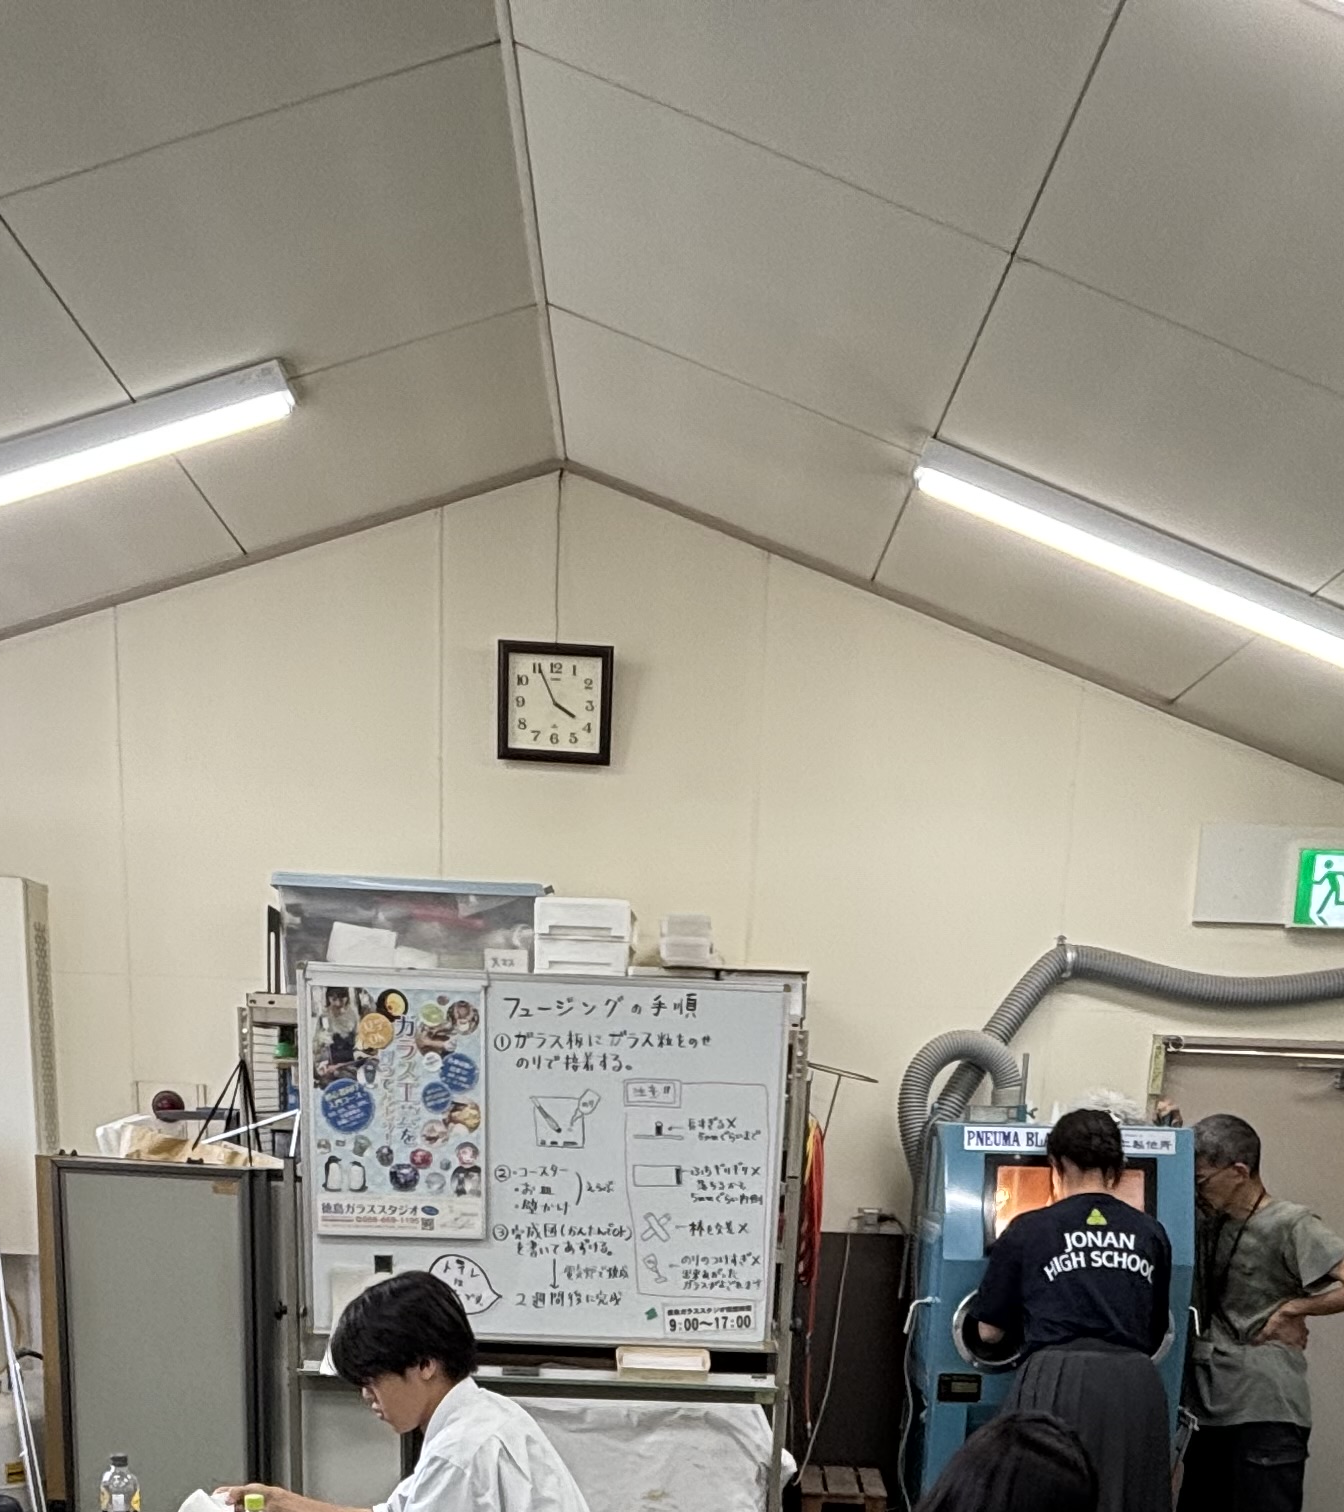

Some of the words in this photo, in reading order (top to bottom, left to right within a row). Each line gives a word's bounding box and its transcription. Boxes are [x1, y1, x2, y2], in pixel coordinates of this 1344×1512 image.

[549, 662, 563, 674] 12
[516, 674, 529, 686] 10
[583, 678, 593, 690] 2
[516, 696, 526, 707] 9
[585, 700, 595, 712] 3
[517, 718, 527, 730] 8
[582, 722, 592, 733] 4
[531, 730, 541, 741] 7
[549, 733, 559, 744] 6
[568, 732, 578, 744] 5
[503, 993, 697, 1019] フュージングの手順
[967, 1131, 1020, 1147] PNEUMA
[1064, 1231, 1135, 1254] JONAN
[1044, 1251, 1086, 1282] HIGH
